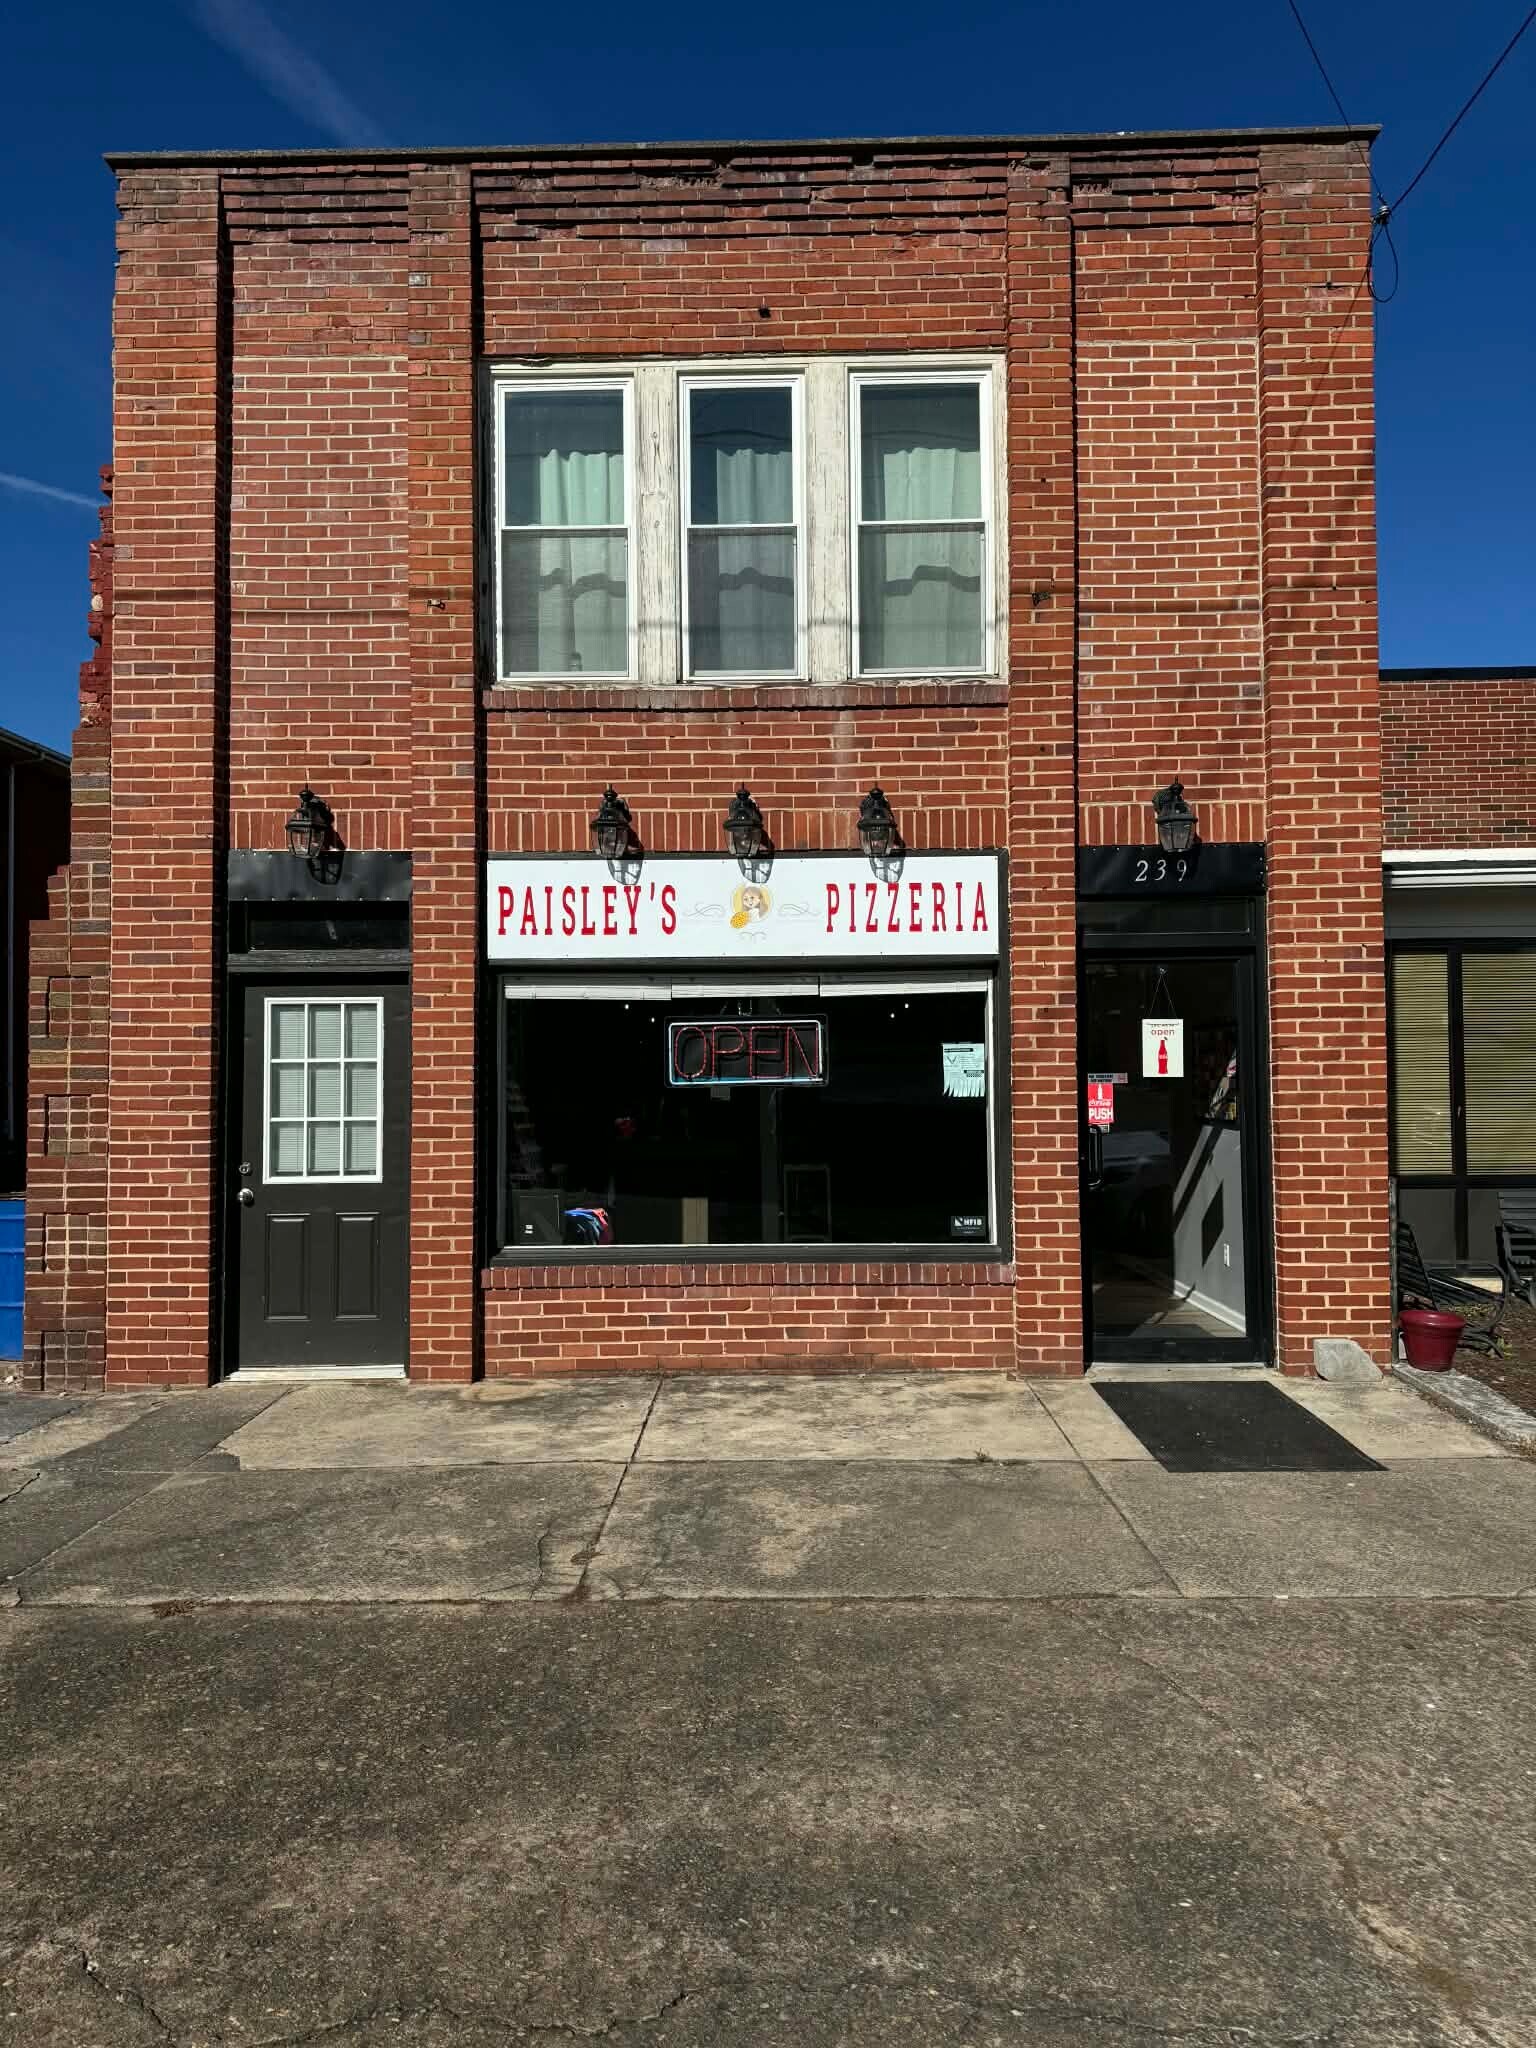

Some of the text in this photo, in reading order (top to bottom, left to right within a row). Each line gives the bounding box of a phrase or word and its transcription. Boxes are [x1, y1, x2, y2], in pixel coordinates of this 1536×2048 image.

[1135, 859, 1187, 881] 239
[498, 882, 988, 936] PAISLEY'S PIZZERIA
[1151, 1029, 1175, 1037] open
[674, 1025, 818, 1078] OPEN
[1088, 1107, 1113, 1120] PUSH
